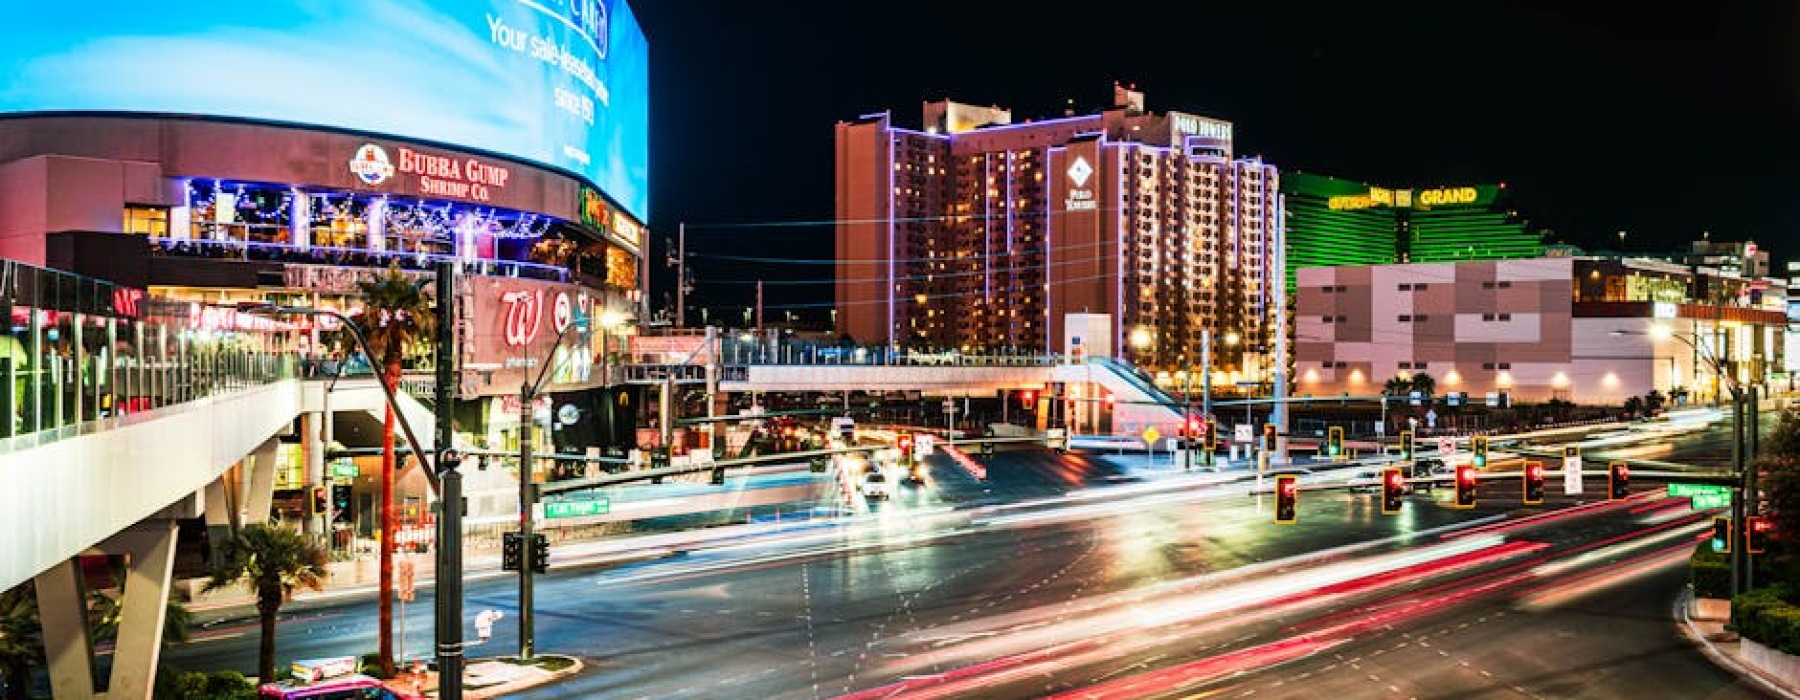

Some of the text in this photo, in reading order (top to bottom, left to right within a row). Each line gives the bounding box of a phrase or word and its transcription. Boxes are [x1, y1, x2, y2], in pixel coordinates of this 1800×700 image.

[486, 13, 527, 52] Your
[397, 147, 460, 181] BUBBA
[466, 158, 509, 188] GUMP
[420, 175, 469, 195] SHRIMP
[1420, 187, 1477, 205] GRAND
